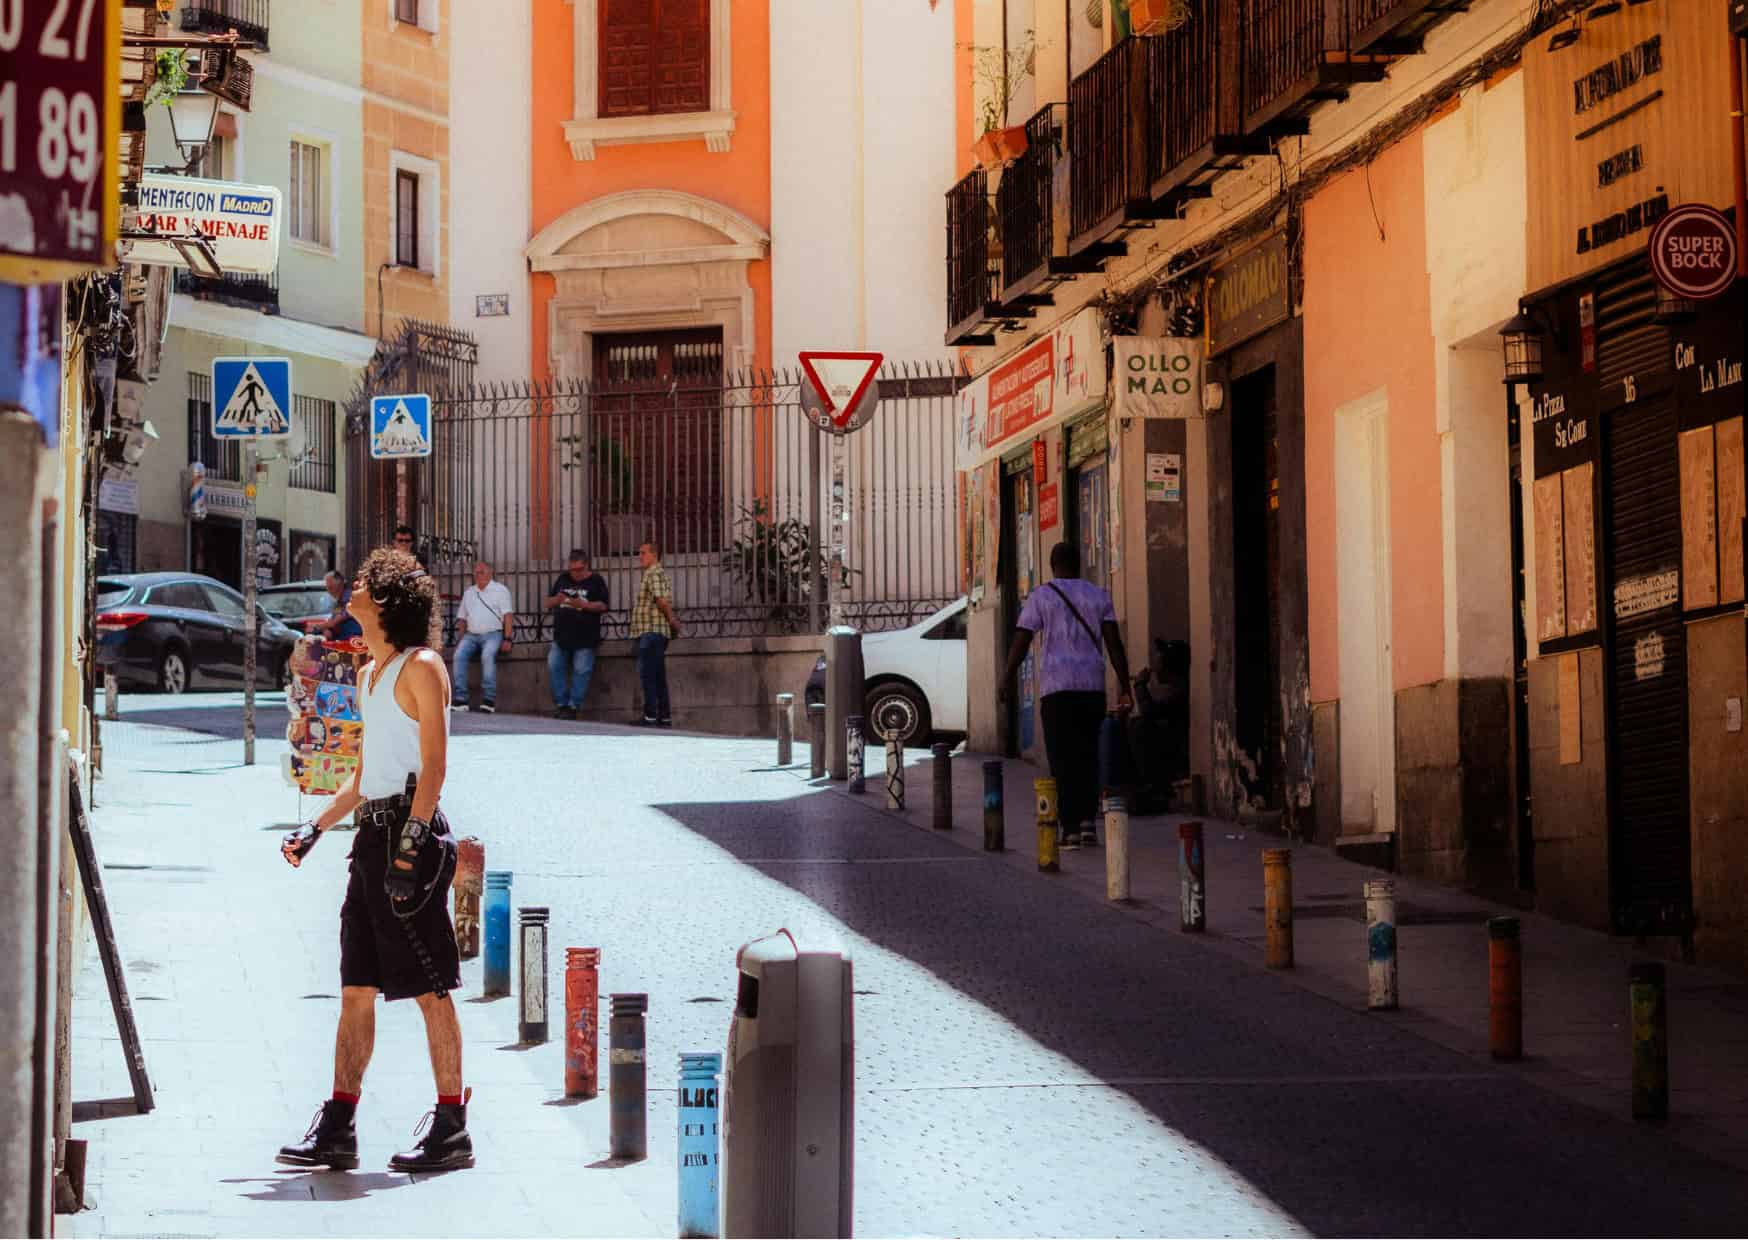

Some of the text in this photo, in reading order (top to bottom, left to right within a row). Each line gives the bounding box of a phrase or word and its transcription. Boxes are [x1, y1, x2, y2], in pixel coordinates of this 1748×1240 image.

[37, 87, 98, 182] 89
[222, 196, 272, 214] MADRID
[201, 219, 269, 241] MENAJE
[1667, 235, 1723, 253] SUPER
[1671, 252, 1722, 269] BOCK
[1127, 354, 1191, 372] OLLO
[1127, 376, 1191, 395] MAO
